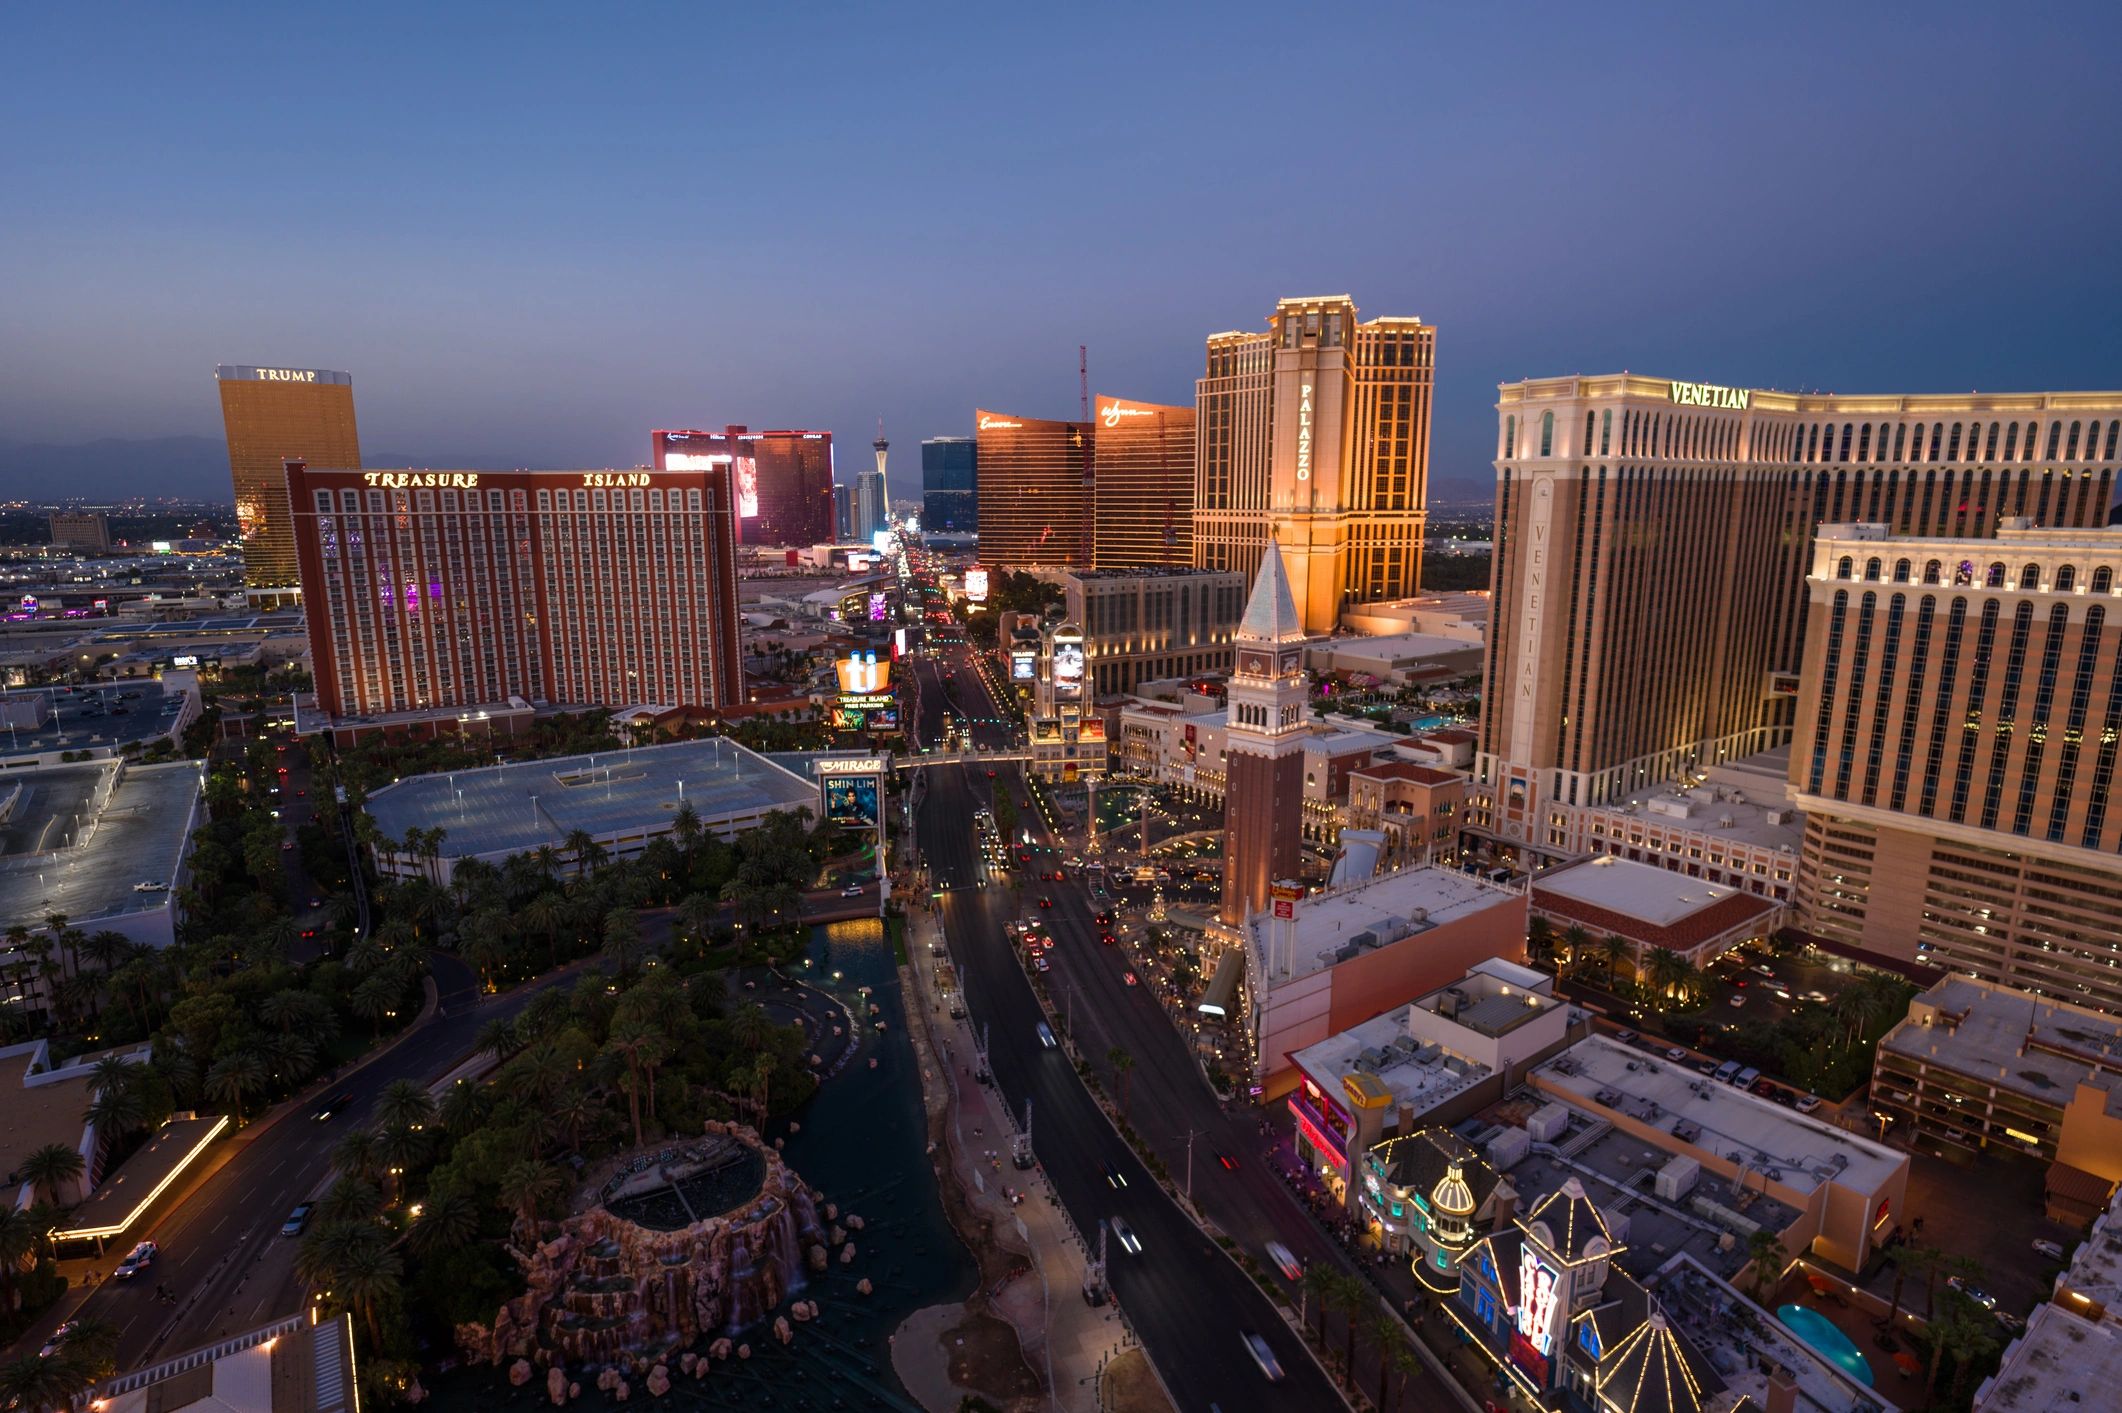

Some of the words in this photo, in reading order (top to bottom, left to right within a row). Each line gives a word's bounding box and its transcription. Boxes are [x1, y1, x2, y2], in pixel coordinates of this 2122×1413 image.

[256, 368, 315, 382] TRUMP
[1671, 381, 1750, 410] VENETIAN
[1297, 385, 1312, 480] PALAZZO
[364, 472, 478, 488] TREASURE
[583, 473, 651, 487] ISLAND
[1523, 525, 1545, 697] VENETIAN
[840, 695, 866, 703] TREASURE
[868, 694, 889, 702] ISLAND
[829, 760, 881, 772] MIRAGE
[828, 780, 854, 789] SHIN
[857, 780, 875, 788] LIM
